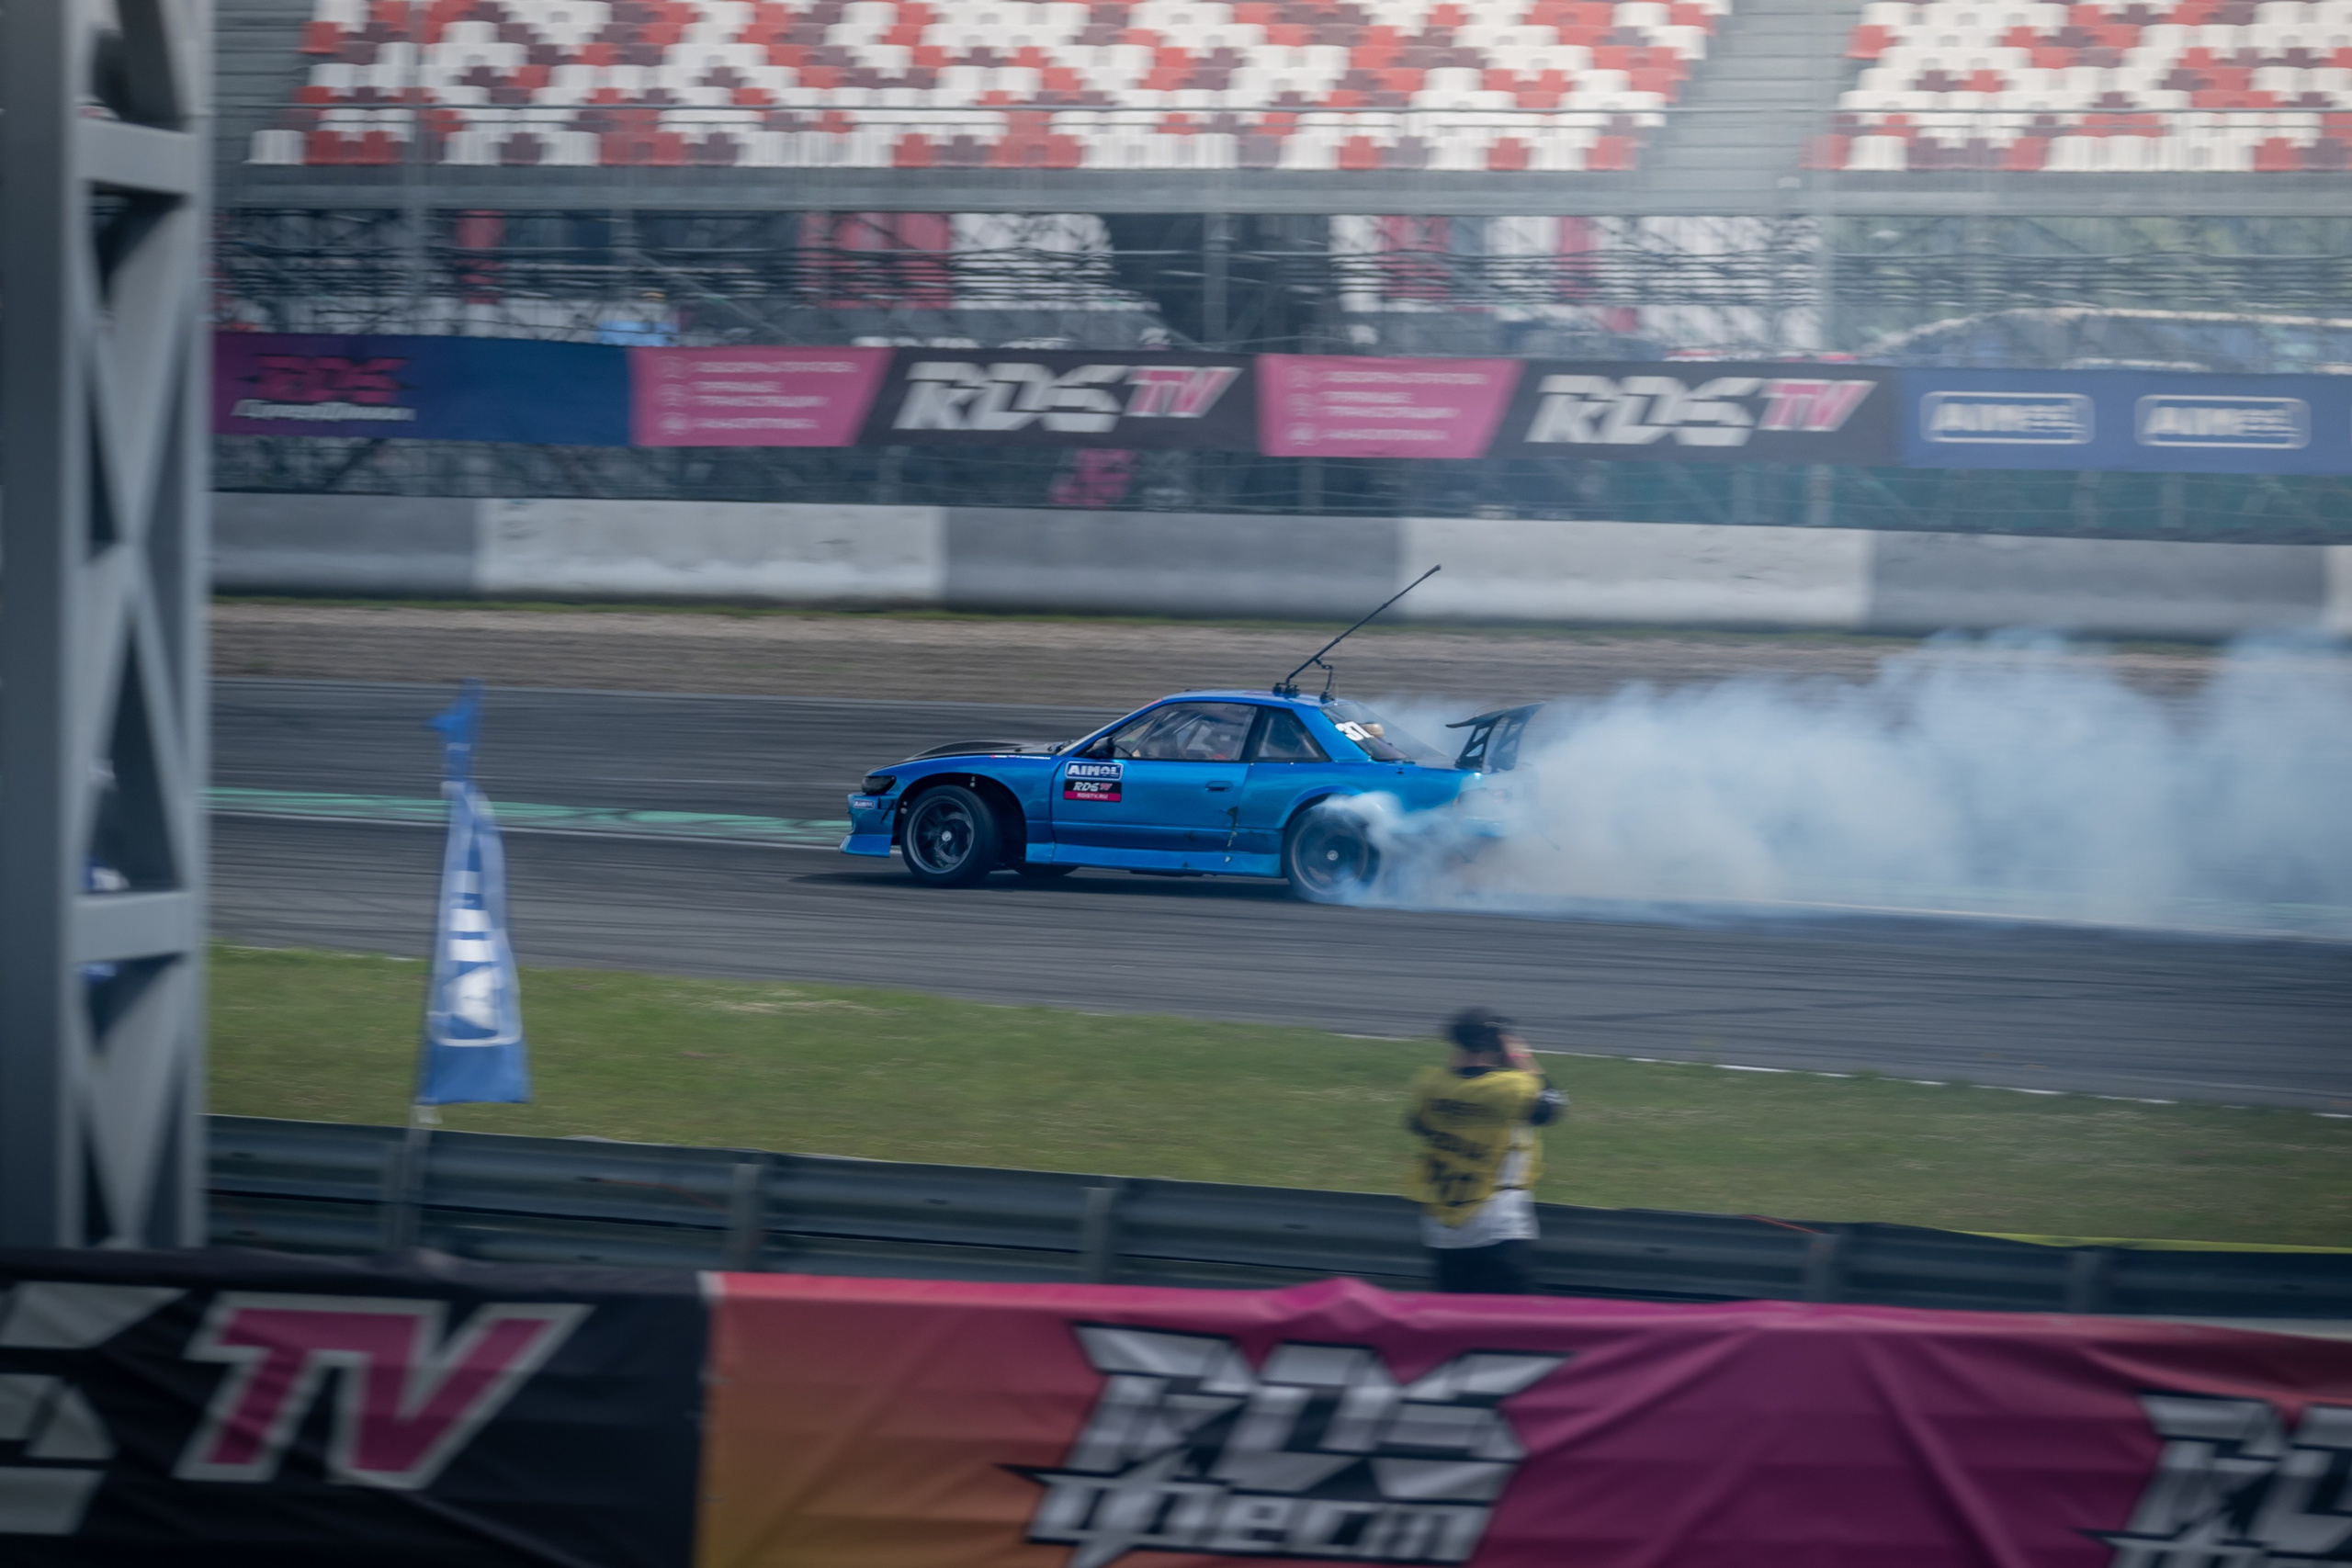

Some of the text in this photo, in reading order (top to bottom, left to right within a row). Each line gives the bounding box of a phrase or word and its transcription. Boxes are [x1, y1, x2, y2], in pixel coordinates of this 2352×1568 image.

[1068, 764, 1119, 776] AIMOL
[173, 1291, 595, 1490] TV
[1058, 1323, 1569, 1503] RDS
